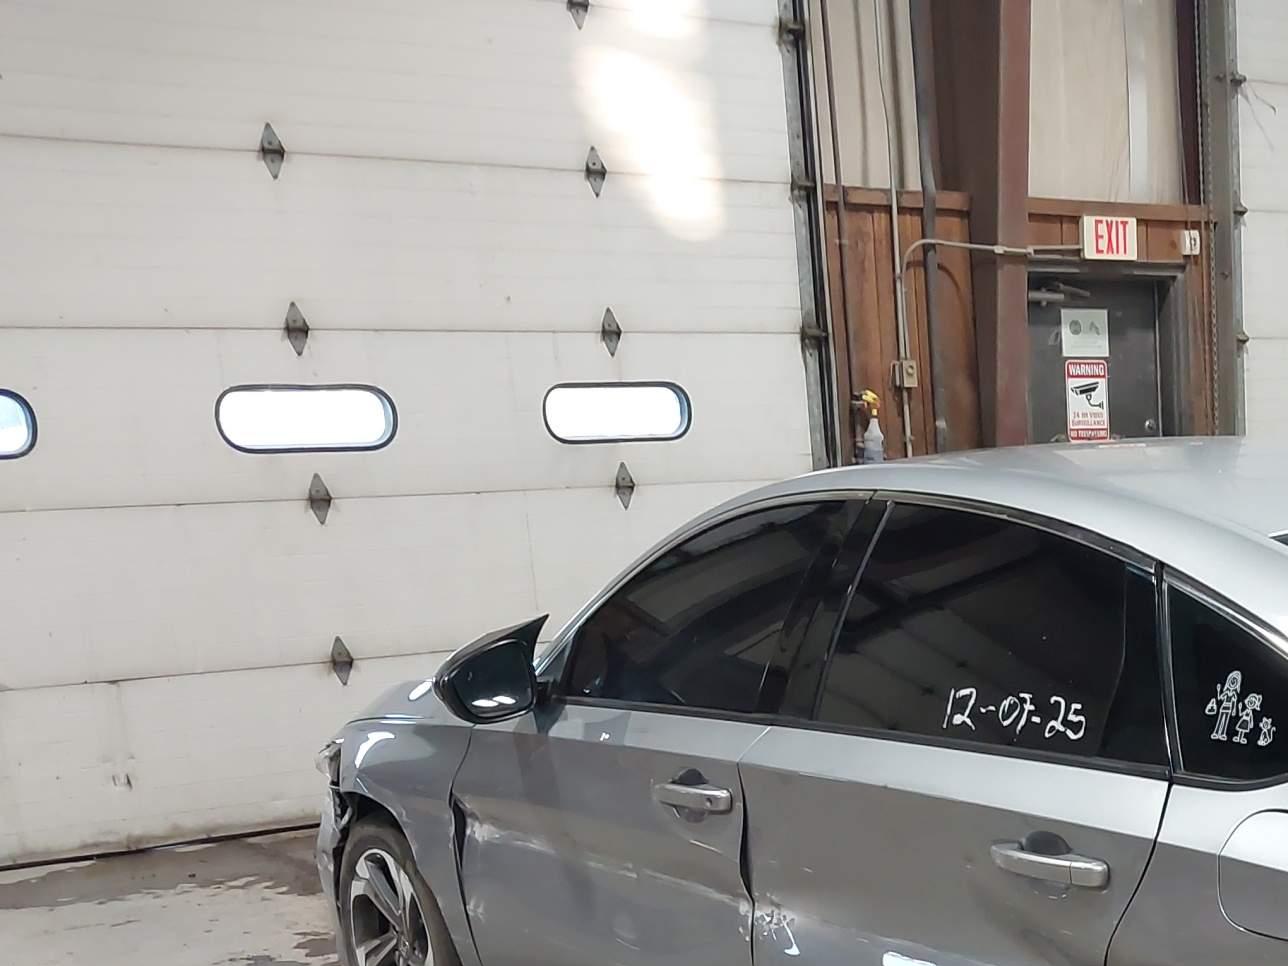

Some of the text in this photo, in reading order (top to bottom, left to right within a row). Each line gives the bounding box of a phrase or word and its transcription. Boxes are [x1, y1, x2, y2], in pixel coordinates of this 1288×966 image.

[1094, 219, 1129, 255] EXIT
[1068, 363, 1105, 376] WARNING
[942, 687, 1087, 740] 12-07-25
